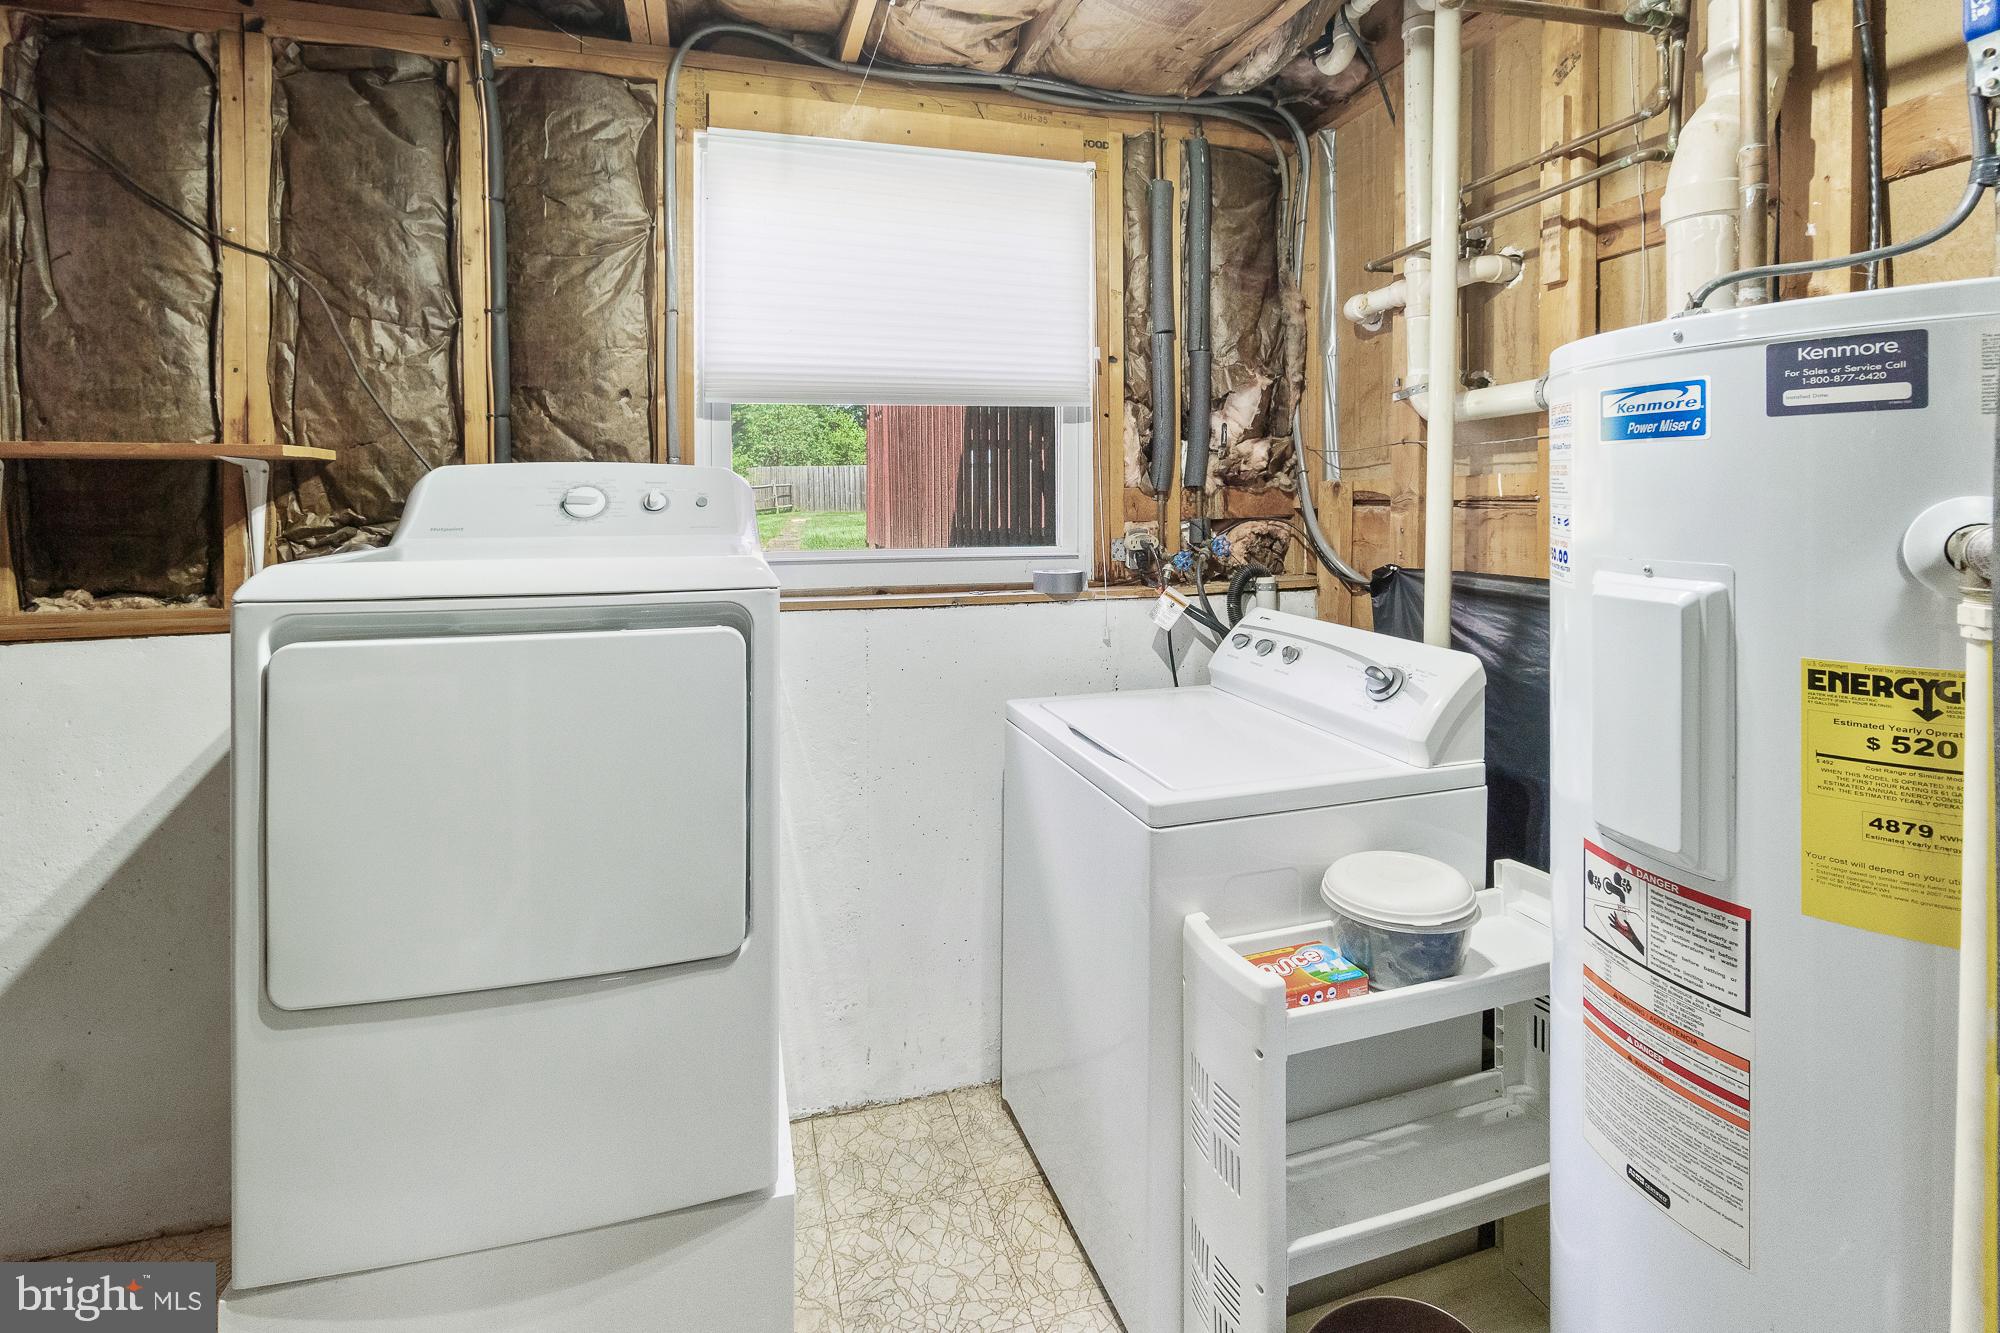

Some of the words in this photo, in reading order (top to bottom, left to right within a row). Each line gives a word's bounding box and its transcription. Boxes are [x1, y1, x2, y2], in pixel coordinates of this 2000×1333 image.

[1797, 341, 1900, 361] Kenmore
[1802, 367, 1828, 376] Sales
[1844, 363, 1882, 372] Service
[1885, 361, 1906, 369] Call
[1802, 372, 1887, 385] 1-800-877-6420
[1616, 398, 1698, 414] Kenmore
[1627, 422, 1658, 434] Power
[1659, 419, 1692, 432] Miser
[1692, 417, 1701, 430] 6
[1833, 718, 1885, 731] Estimated
[1888, 724, 1922, 736] Yearly
[1866, 737, 1881, 752] $
[1891, 735, 1958, 759] 520
[1821, 767, 1842, 775] WHEN
[1863, 774, 1888, 782] MODEL
[1902, 779, 1945, 789] OPERATED
[1883, 768, 1907, 776] Range
[1918, 772, 1944, 781] Similar
[1823, 779, 1866, 791] ESTIMATED
[1867, 786, 1898, 796] ANNUAL
[1900, 791, 1934, 801] ENERGY
[1854, 778, 1873, 786] FIRST
[1875, 781, 1898, 789] HOUR
[1899, 785, 1929, 794] RATING
[1854, 790, 1898, 802] ESTIMATED
[1899, 798, 1930, 806] YEARLY
[1868, 817, 1934, 838] 4879
[1865, 833, 1904, 845] Estimated
[1906, 840, 1932, 850] Yearly
[1805, 850, 1826, 861] Your
[1829, 855, 1848, 866] cost
[1850, 860, 1866, 870] will
[1868, 863, 1905, 877] depend
[1907, 871, 1920, 879] on
[1923, 874, 1945, 883] your
[1636, 869, 1680, 894] DANGER
[1619, 996, 1646, 1017] WARNING
[1649, 1015, 1699, 1047] ADVERTENCIA
[1633, 1040, 1665, 1064] DANGER
[1634, 1060, 1664, 1084] WARNING
